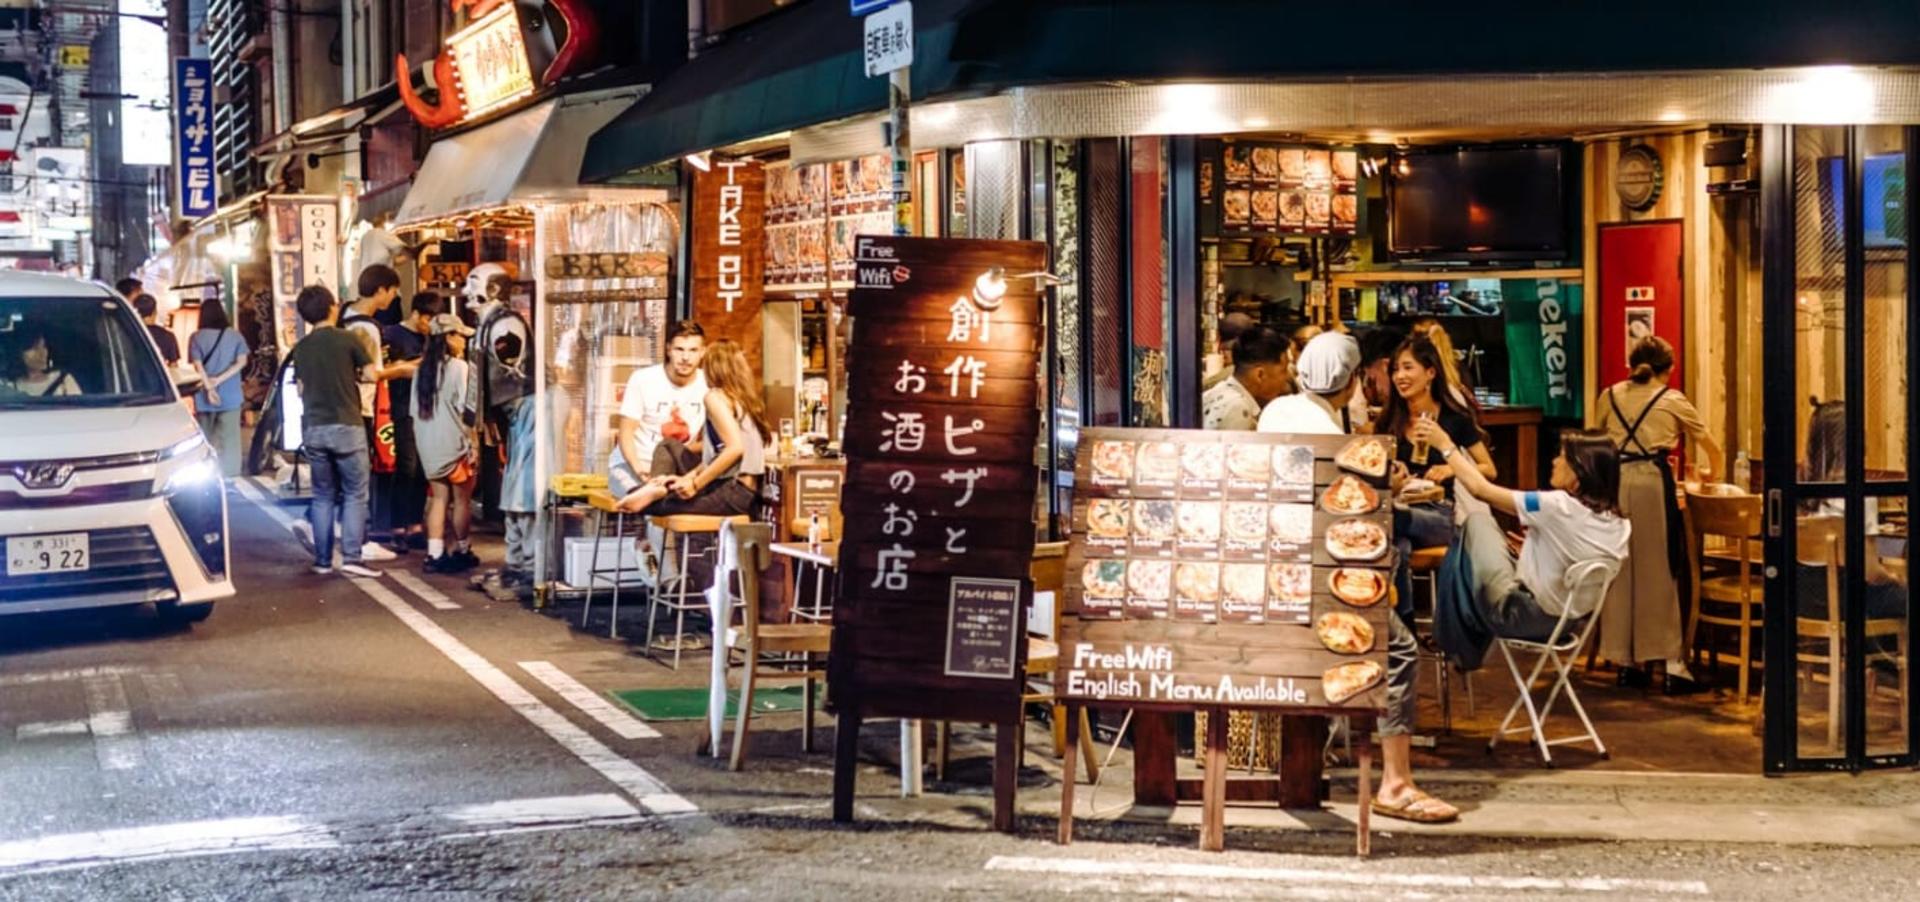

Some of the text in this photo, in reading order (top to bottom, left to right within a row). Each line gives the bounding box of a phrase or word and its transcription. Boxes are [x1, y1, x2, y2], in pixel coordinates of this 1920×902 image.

[184, 66, 211, 210] ショウサンビル
[310, 207, 326, 252] COIN
[717, 161, 747, 312] TAKE OUT
[858, 238, 895, 258] Free
[563, 254, 631, 276] BAR
[860, 266, 891, 284] Wifi
[941, 295, 990, 554] 創作ピザと
[871, 359, 927, 591] お酒のお店
[1067, 670, 1306, 703] English Menu Available
